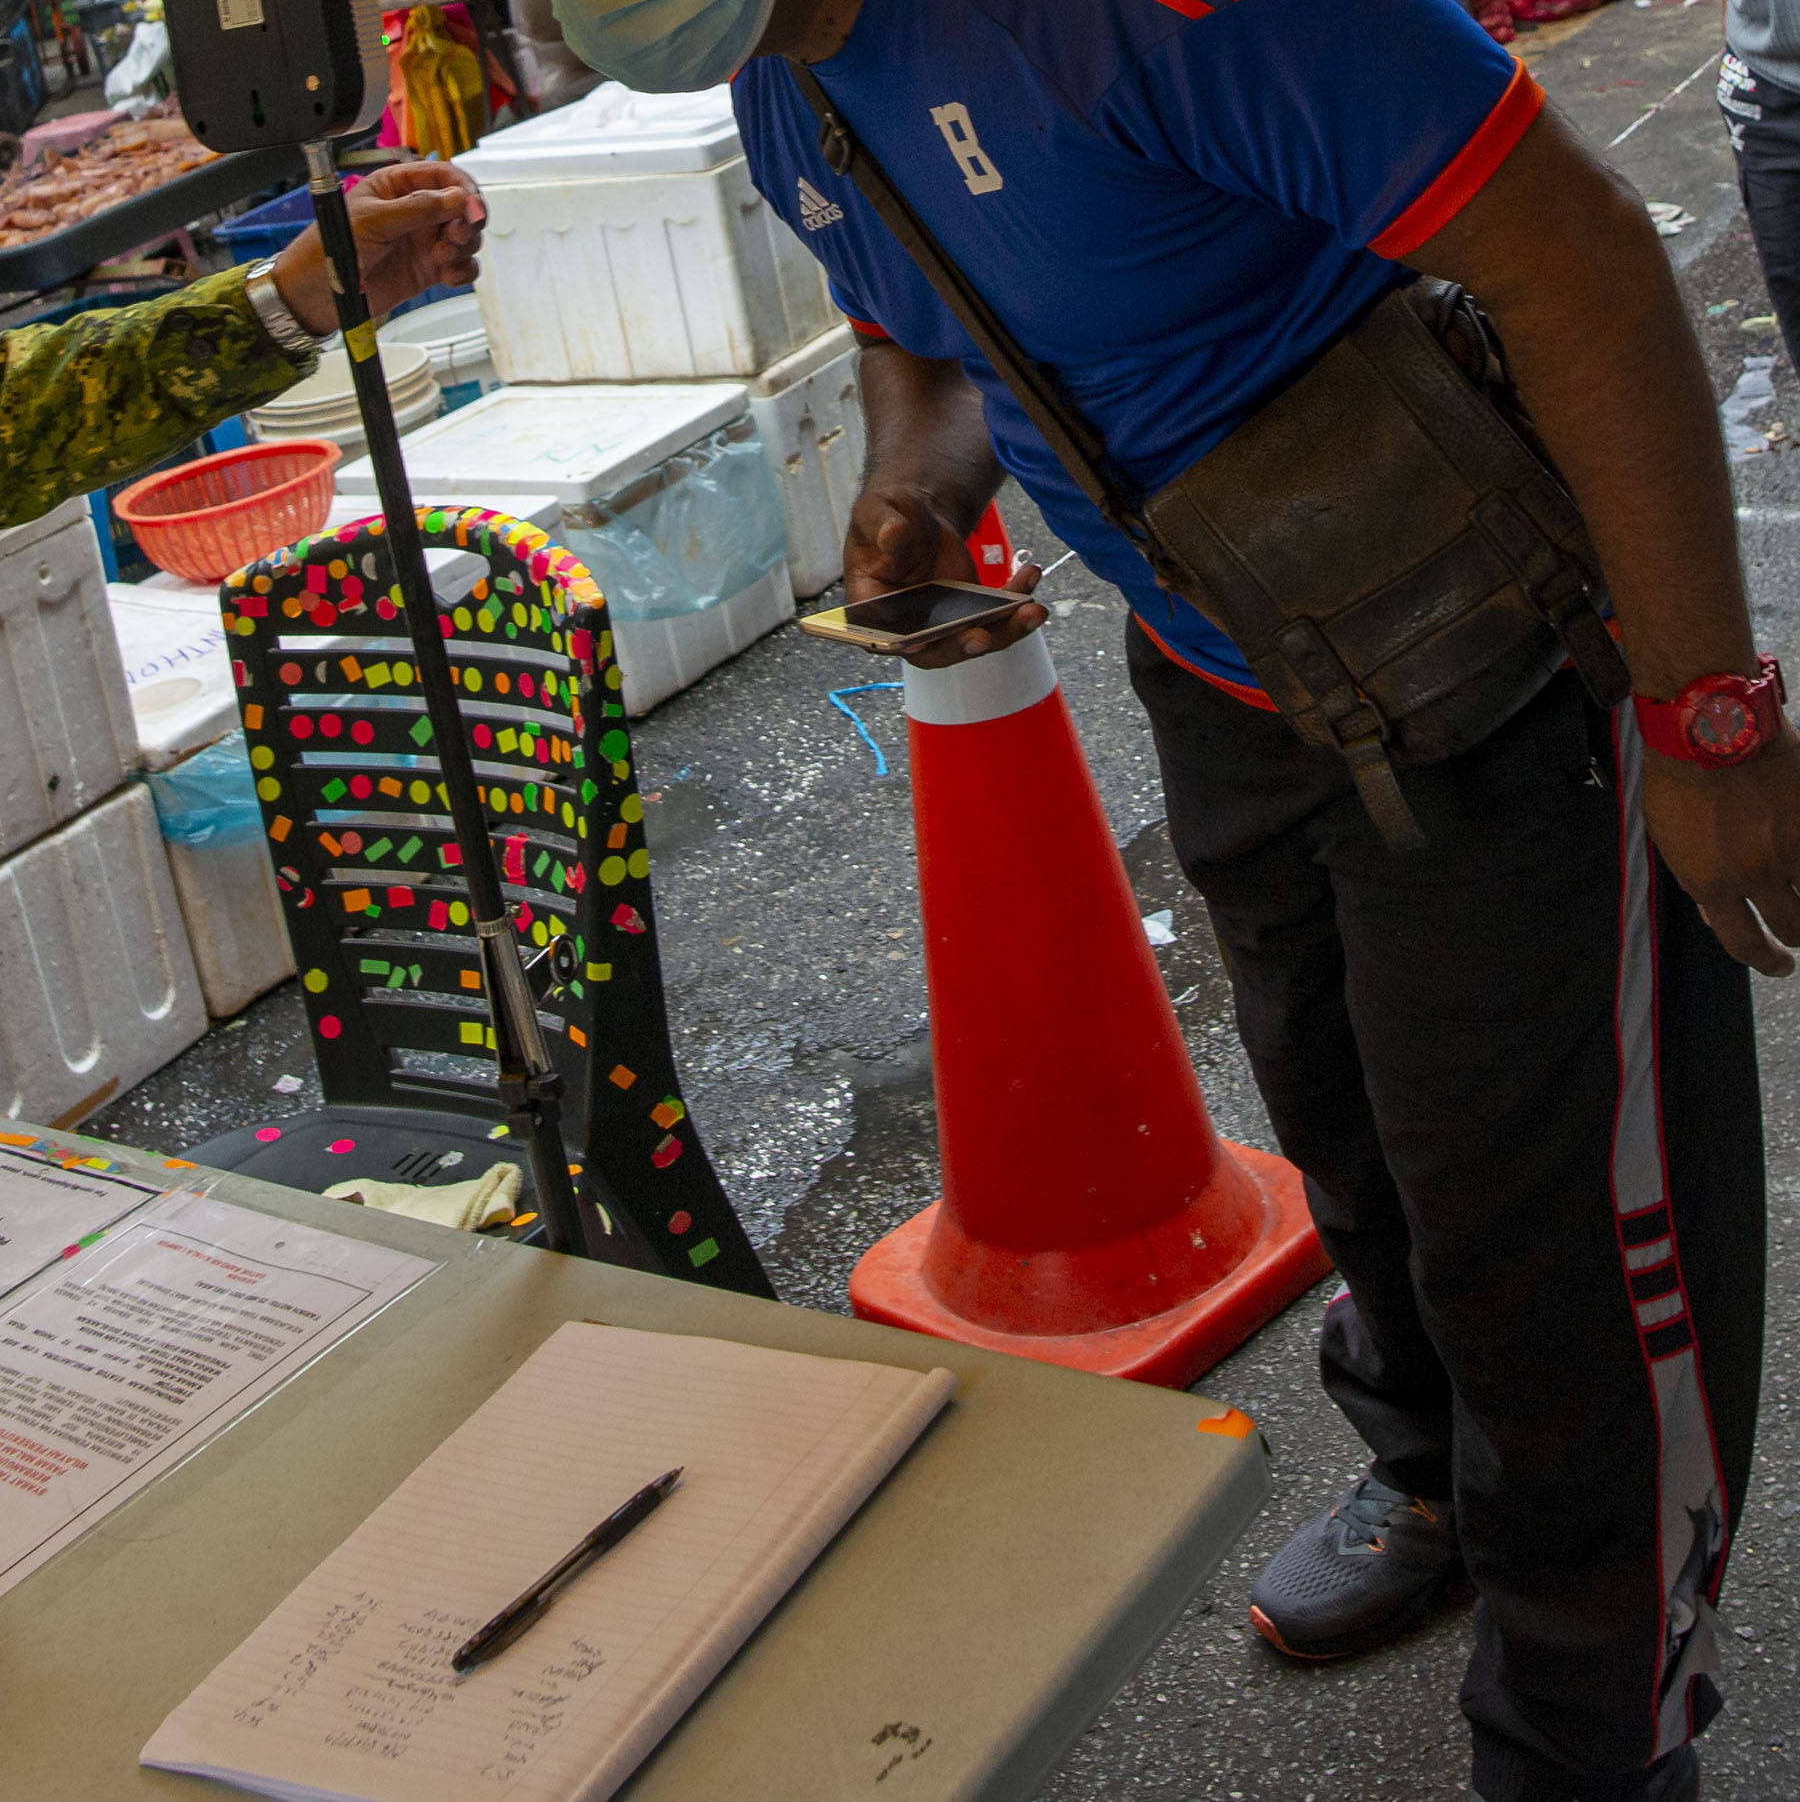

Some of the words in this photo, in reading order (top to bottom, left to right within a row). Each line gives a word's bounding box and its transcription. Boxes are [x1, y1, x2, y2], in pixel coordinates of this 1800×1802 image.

[802, 203, 844, 231] adidas
[31, 1457, 71, 1476] PASAR
[6, 1475, 50, 1496] SYARAT
